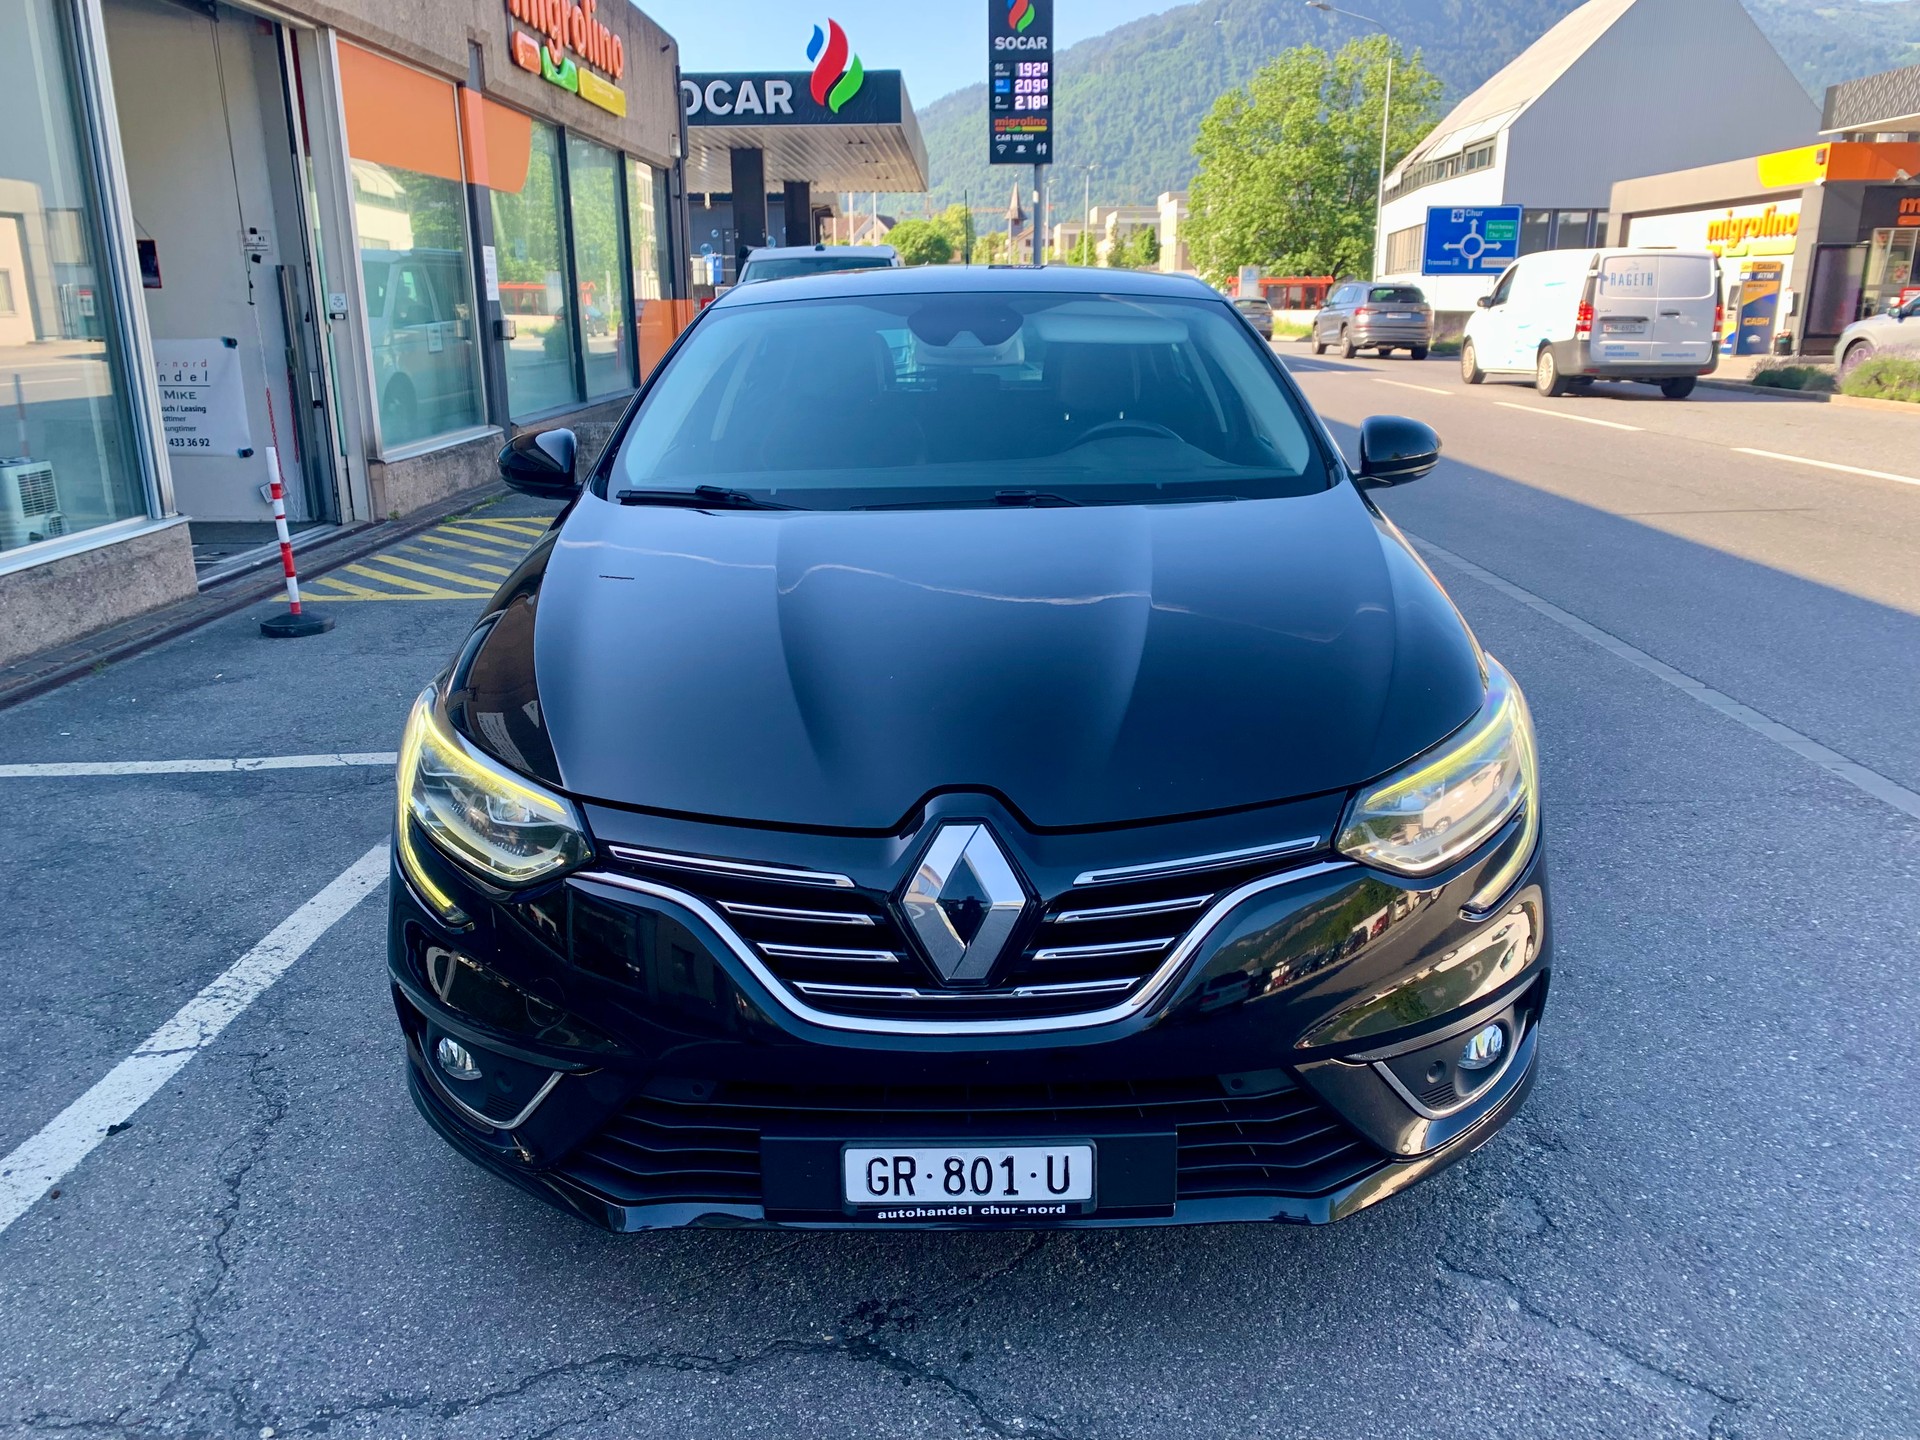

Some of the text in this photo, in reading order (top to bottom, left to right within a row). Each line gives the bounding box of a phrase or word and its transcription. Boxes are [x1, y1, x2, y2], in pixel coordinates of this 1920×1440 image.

[994, 36, 1047, 50] SOCAR
[994, 116, 1047, 128] migrolino
[995, 133, 1034, 141] CAR WASH
[1466, 209, 1483, 217] Chur
[1707, 205, 1799, 248] migrolino
[1610, 272, 1653, 286] RAGETH
[180, 405, 207, 414] Leasing
[169, 438, 210, 446] 433 36 92
[877, 1204, 1066, 1218] autohandel chur-nord
